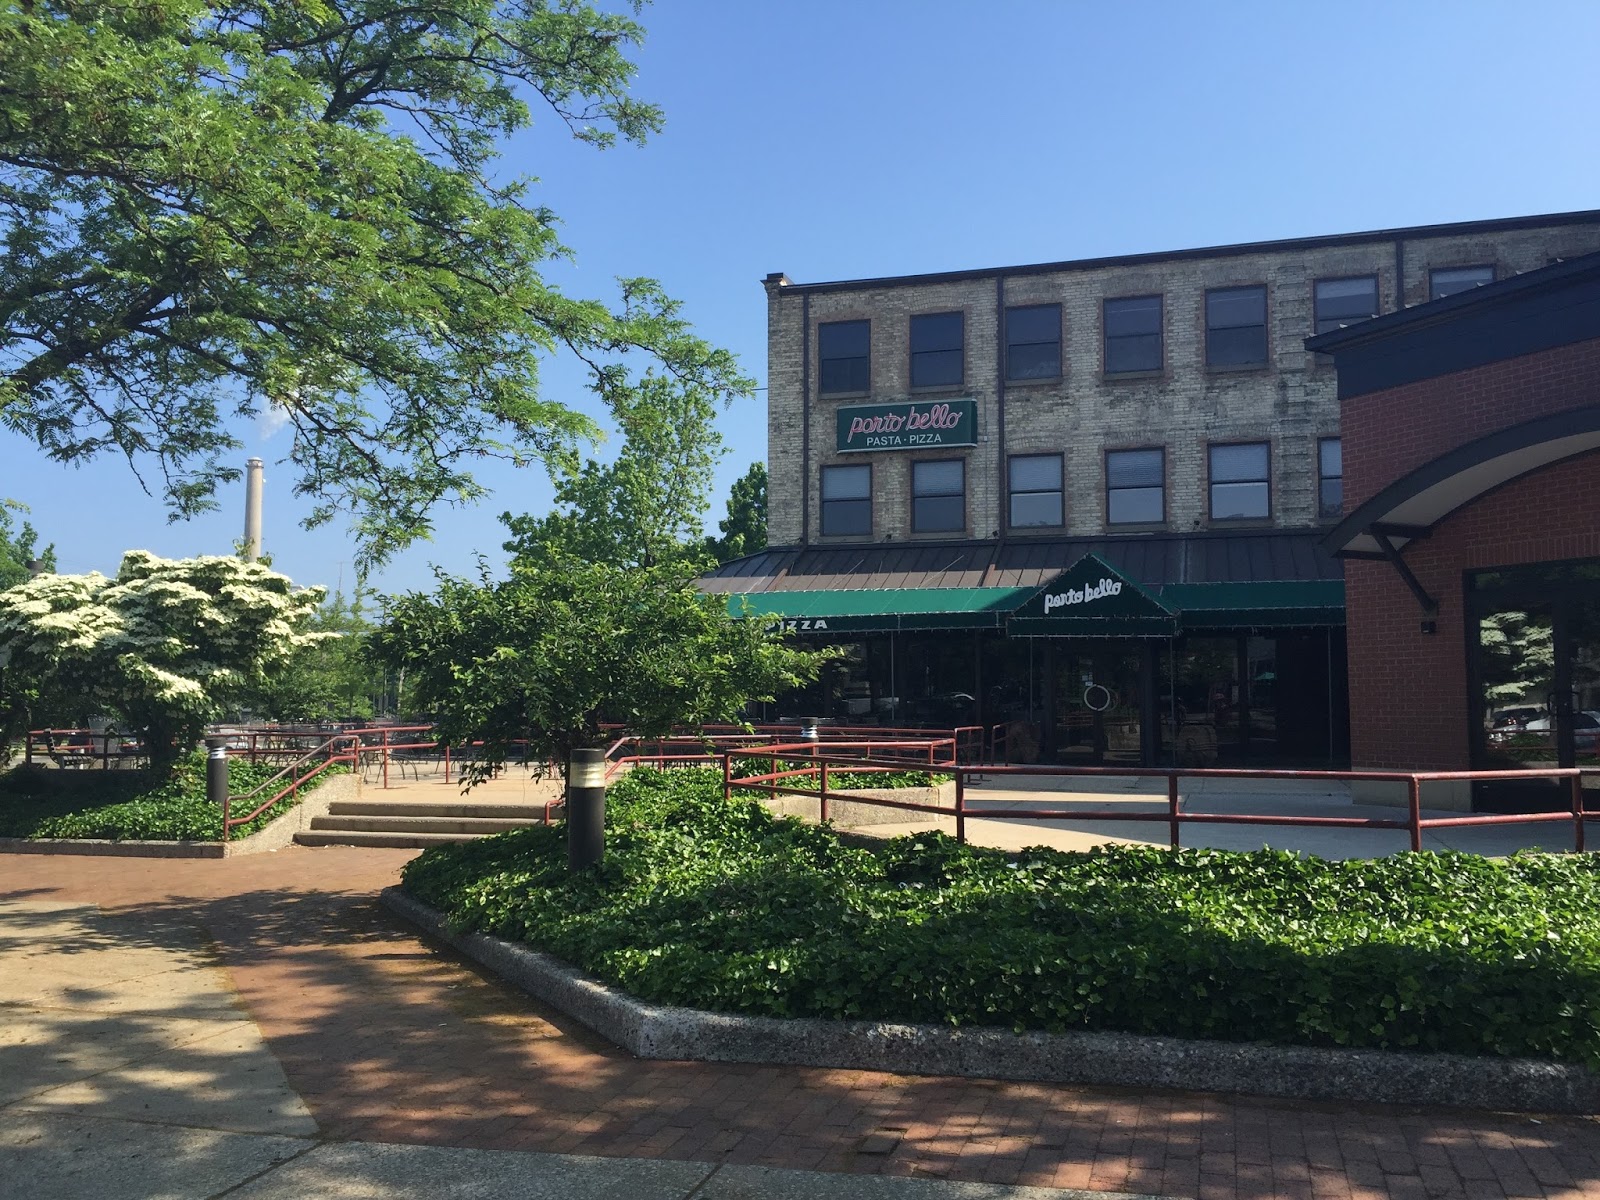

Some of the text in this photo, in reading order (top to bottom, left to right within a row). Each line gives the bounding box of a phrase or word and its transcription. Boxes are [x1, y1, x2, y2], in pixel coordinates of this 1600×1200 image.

[847, 404, 963, 443] porto bello
[866, 433, 942, 446] PASTA PIZZA
[1044, 578, 1122, 614] porto bello
